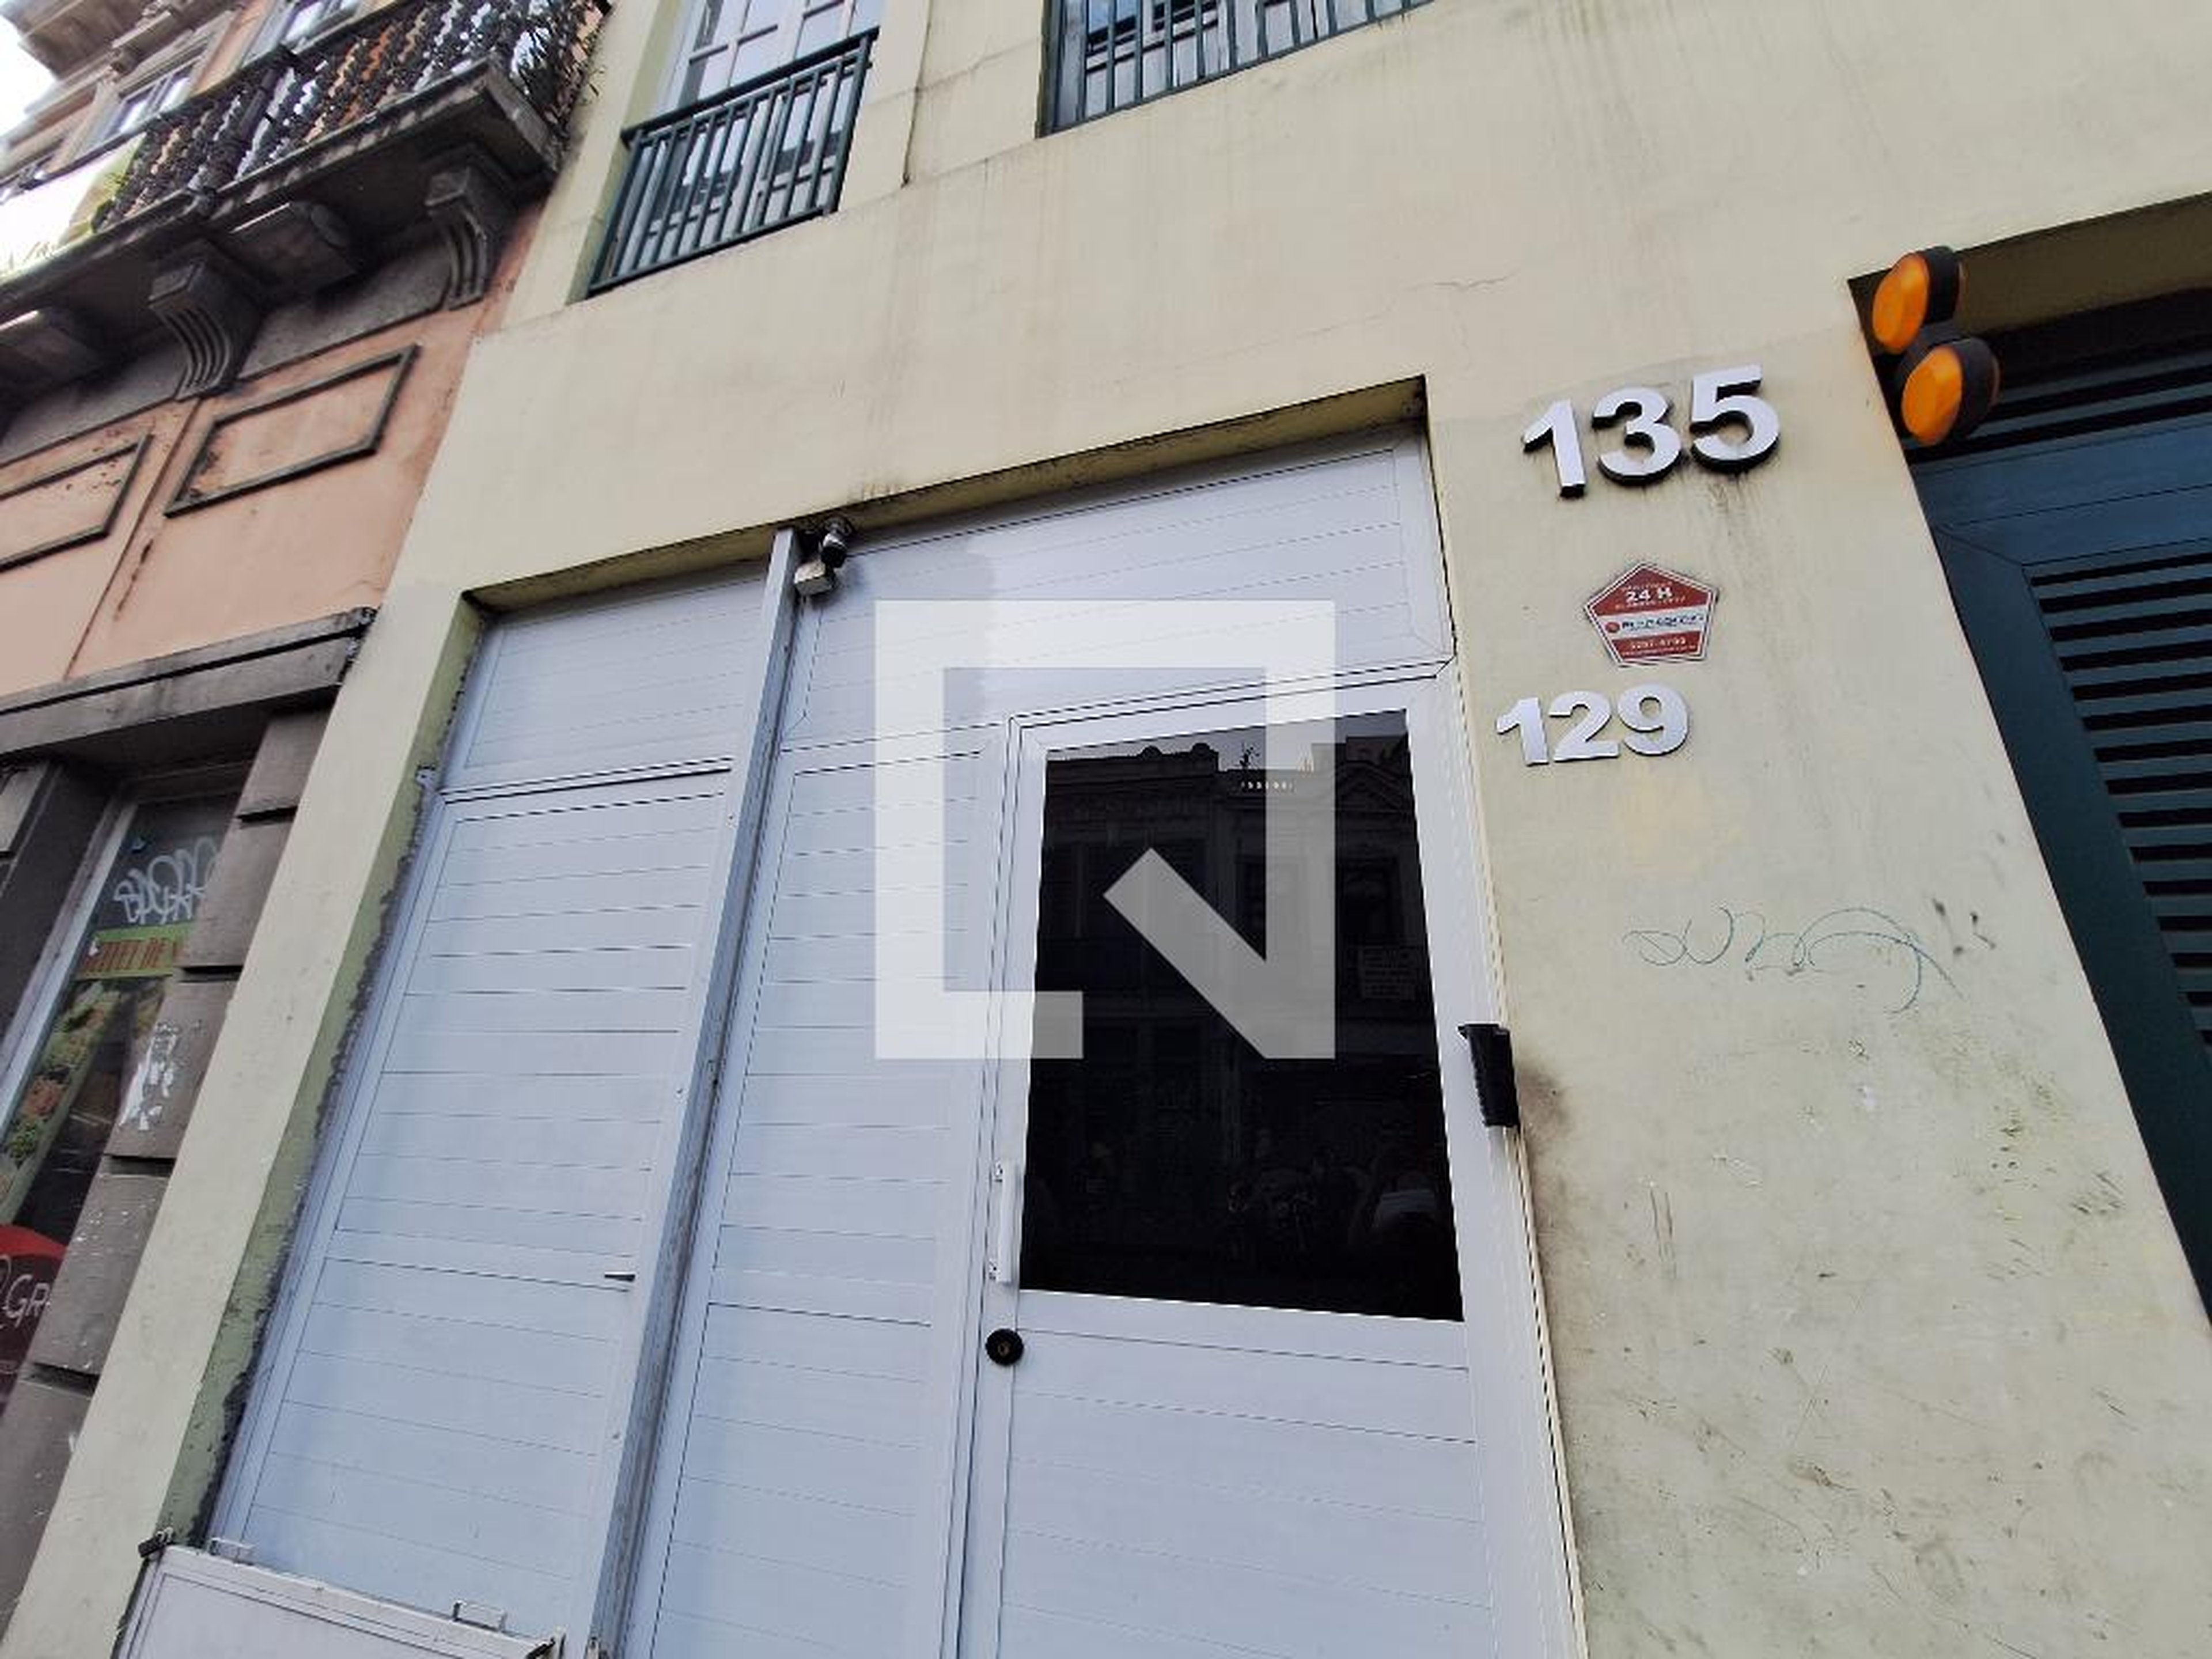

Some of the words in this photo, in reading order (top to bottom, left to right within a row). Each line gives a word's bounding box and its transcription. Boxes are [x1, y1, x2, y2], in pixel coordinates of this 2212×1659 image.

[1522, 363, 1781, 495] 135
[1626, 589, 1652, 603] 24
[1497, 684, 1689, 765] 129
